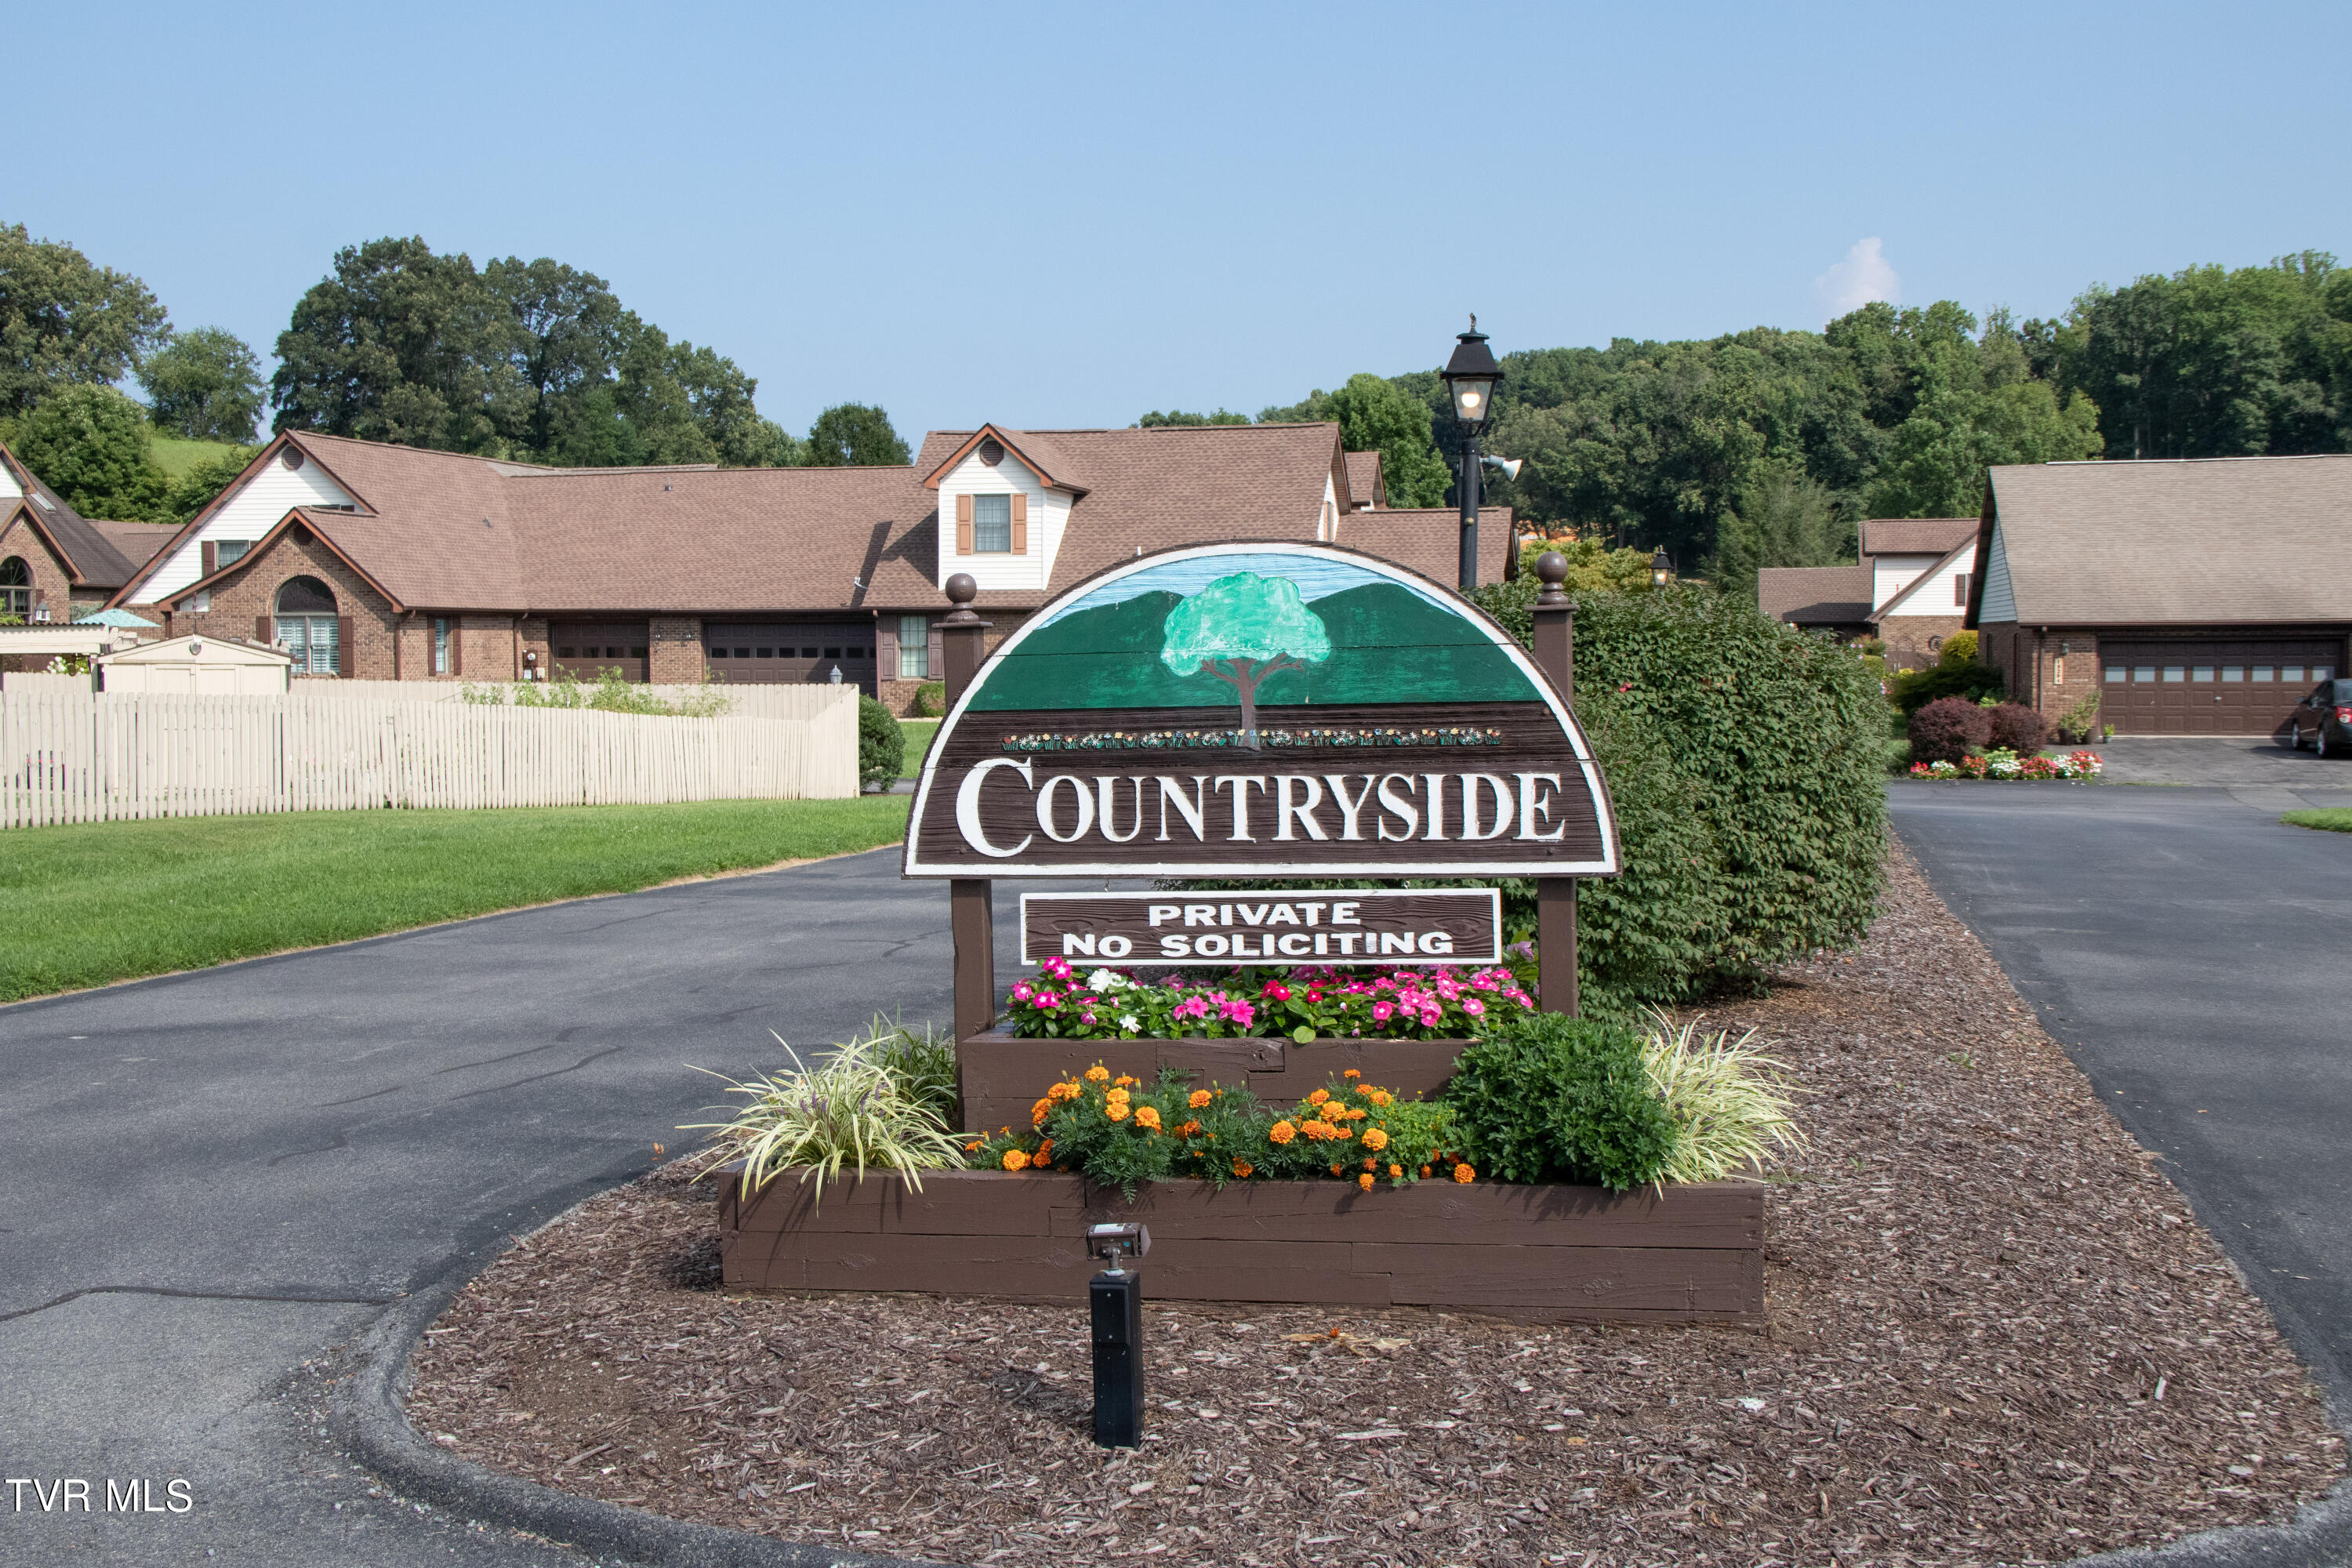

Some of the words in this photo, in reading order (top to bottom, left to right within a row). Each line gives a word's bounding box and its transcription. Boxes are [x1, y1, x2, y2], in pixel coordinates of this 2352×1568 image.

[956, 757, 1566, 858] COUNTRYSIDE
[1149, 902, 1361, 927] PRIVATE
[1063, 933, 1133, 958] NO
[1160, 931, 1454, 957] SOLICITING
